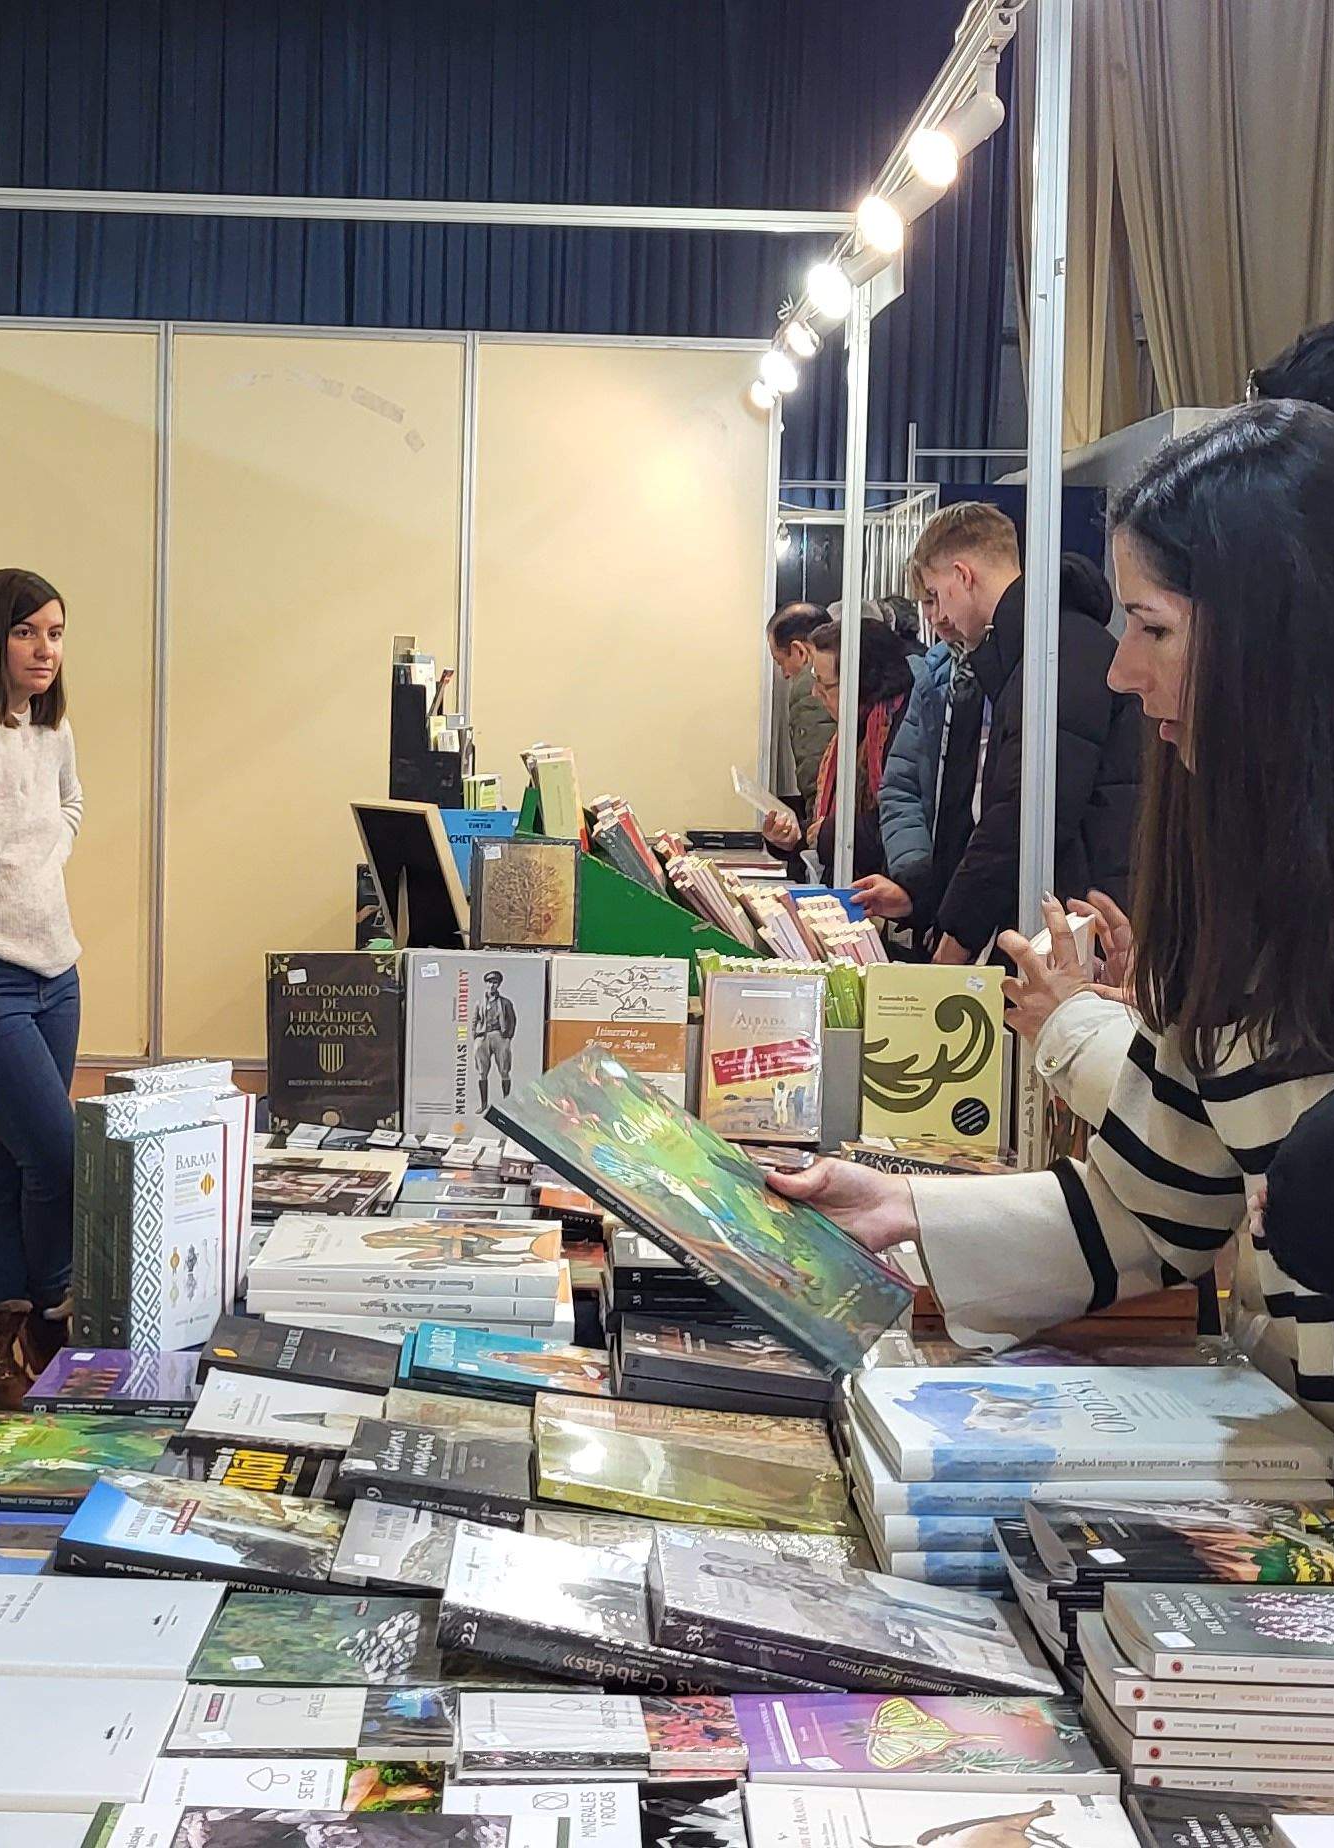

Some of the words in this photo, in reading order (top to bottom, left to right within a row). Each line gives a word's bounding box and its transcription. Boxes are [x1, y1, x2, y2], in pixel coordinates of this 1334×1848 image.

[281, 984, 381, 998] DICCIONARIO
[458, 969, 470, 1024] ROBERT
[322, 998, 340, 1010] DE
[289, 1009, 373, 1023] HERÁLDICA
[284, 1024, 378, 1039] ARAGONESA
[457, 1026, 468, 1043] DE
[455, 1044, 468, 1115] MEMORIAS
[175, 1152, 217, 1171] BARAJA
[70, 1554, 87, 1567] 7
[460, 1620, 479, 1646] 22
[297, 1768, 318, 1800] SETAS
[599, 1791, 616, 1818] ROCAS
[580, 1791, 597, 1840] MINERALES
[600, 1819, 616, 1831] Y
